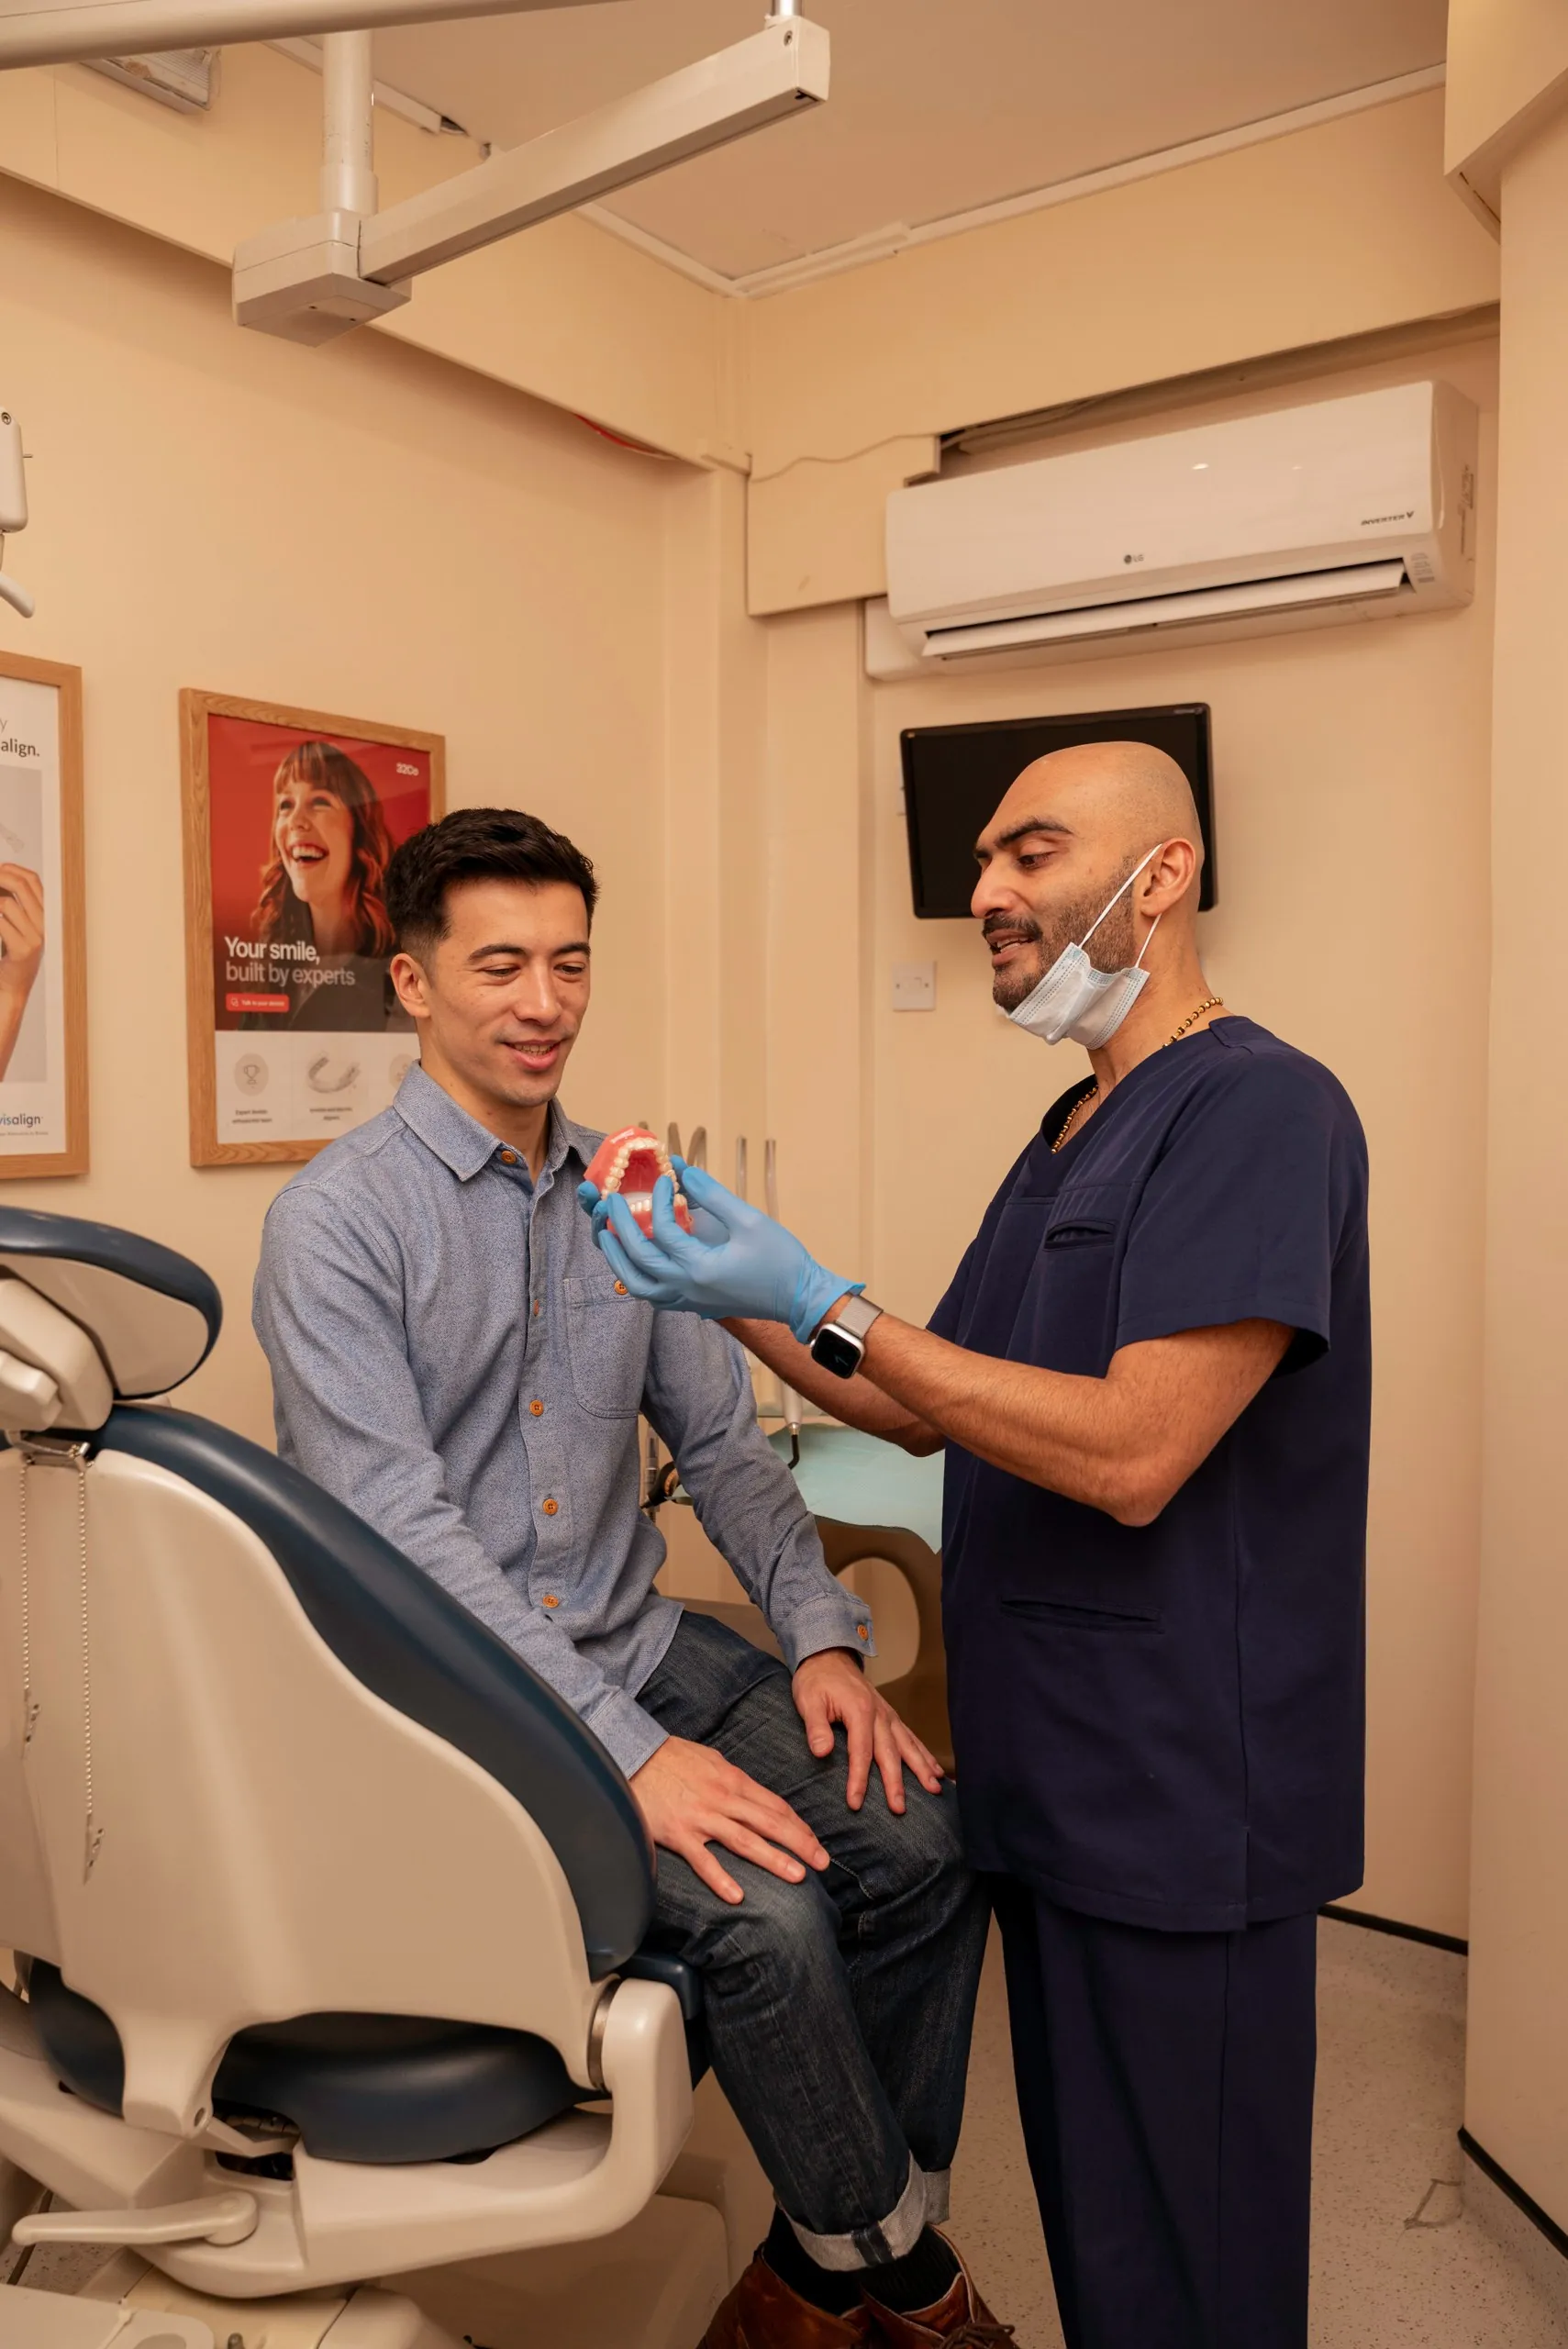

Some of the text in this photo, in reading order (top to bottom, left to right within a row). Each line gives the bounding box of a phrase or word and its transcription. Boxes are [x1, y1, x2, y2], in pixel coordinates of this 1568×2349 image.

[1361, 510, 1415, 526] INVERTER V
[224, 936, 320, 965] Your smile,
[226, 961, 356, 989] built by experts
